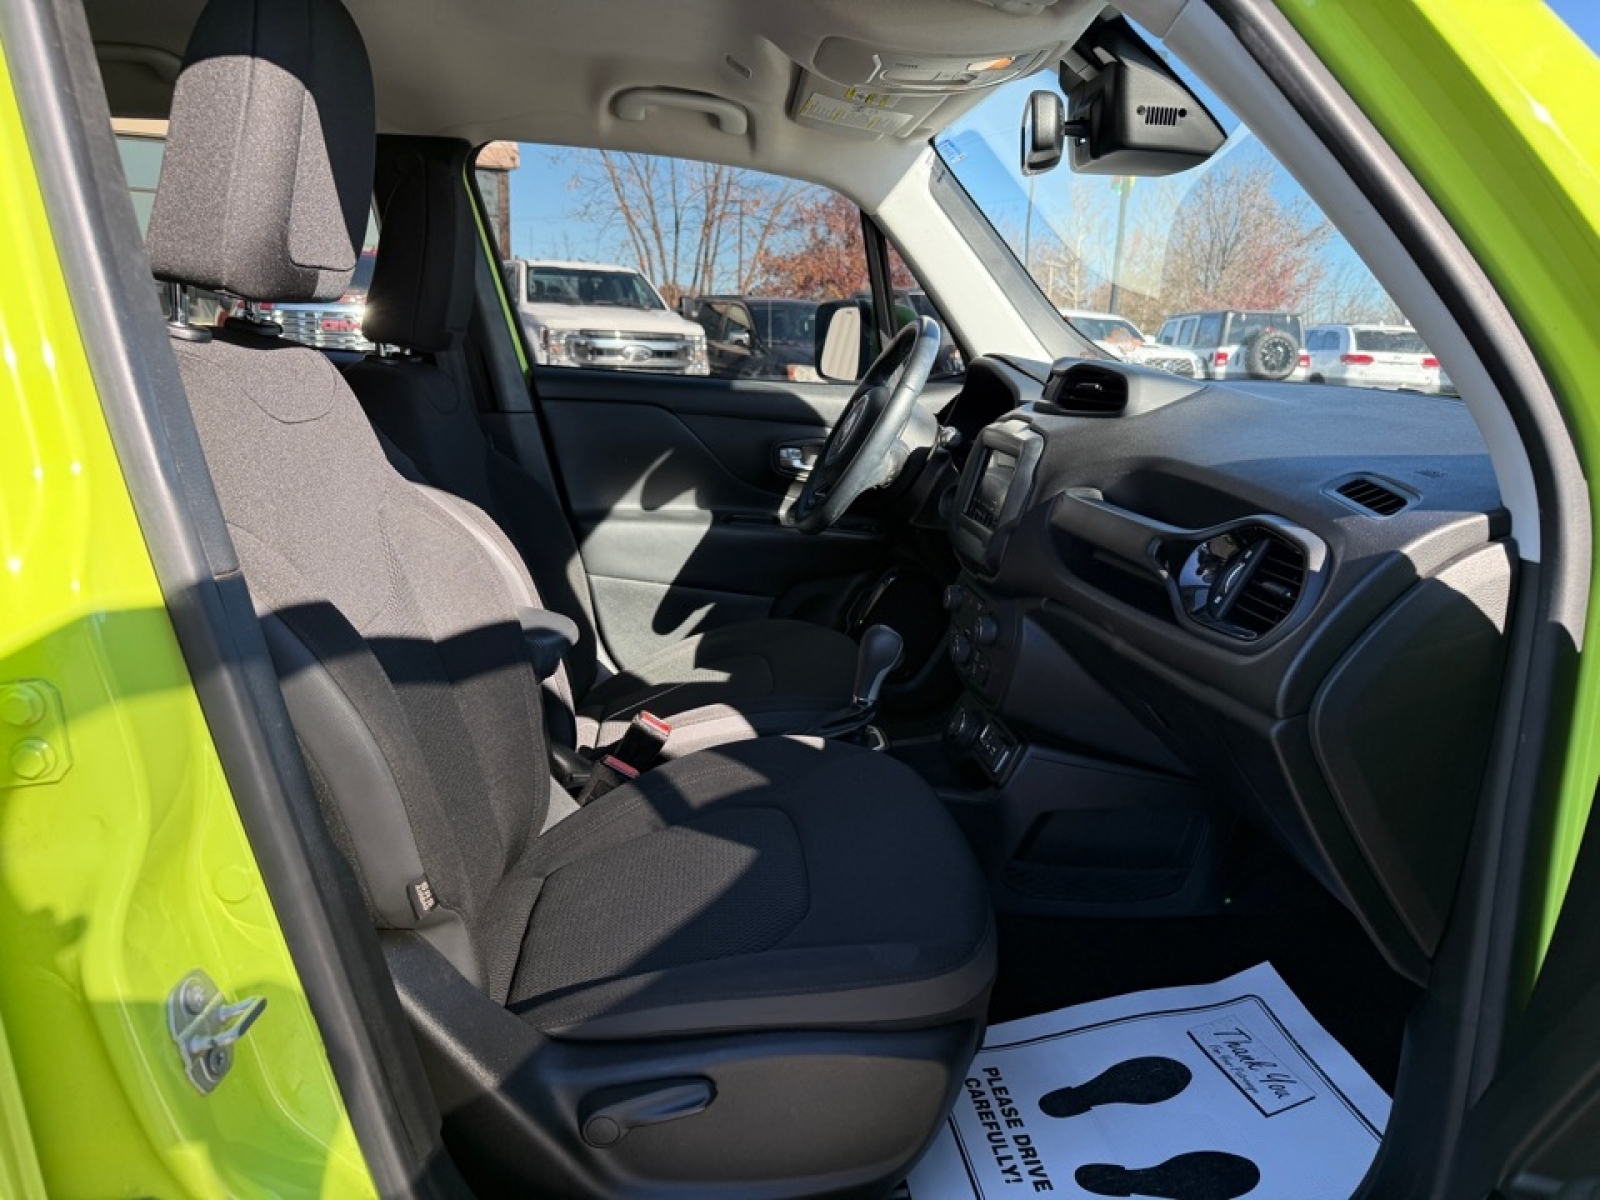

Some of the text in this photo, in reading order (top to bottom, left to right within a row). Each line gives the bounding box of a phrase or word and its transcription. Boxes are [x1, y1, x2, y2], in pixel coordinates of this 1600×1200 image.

[1213, 1027, 1298, 1099] Thank You
[965, 1078, 1024, 1184] CAREFULLY!
[982, 1067, 1054, 1192] PLEASE DRIVE
